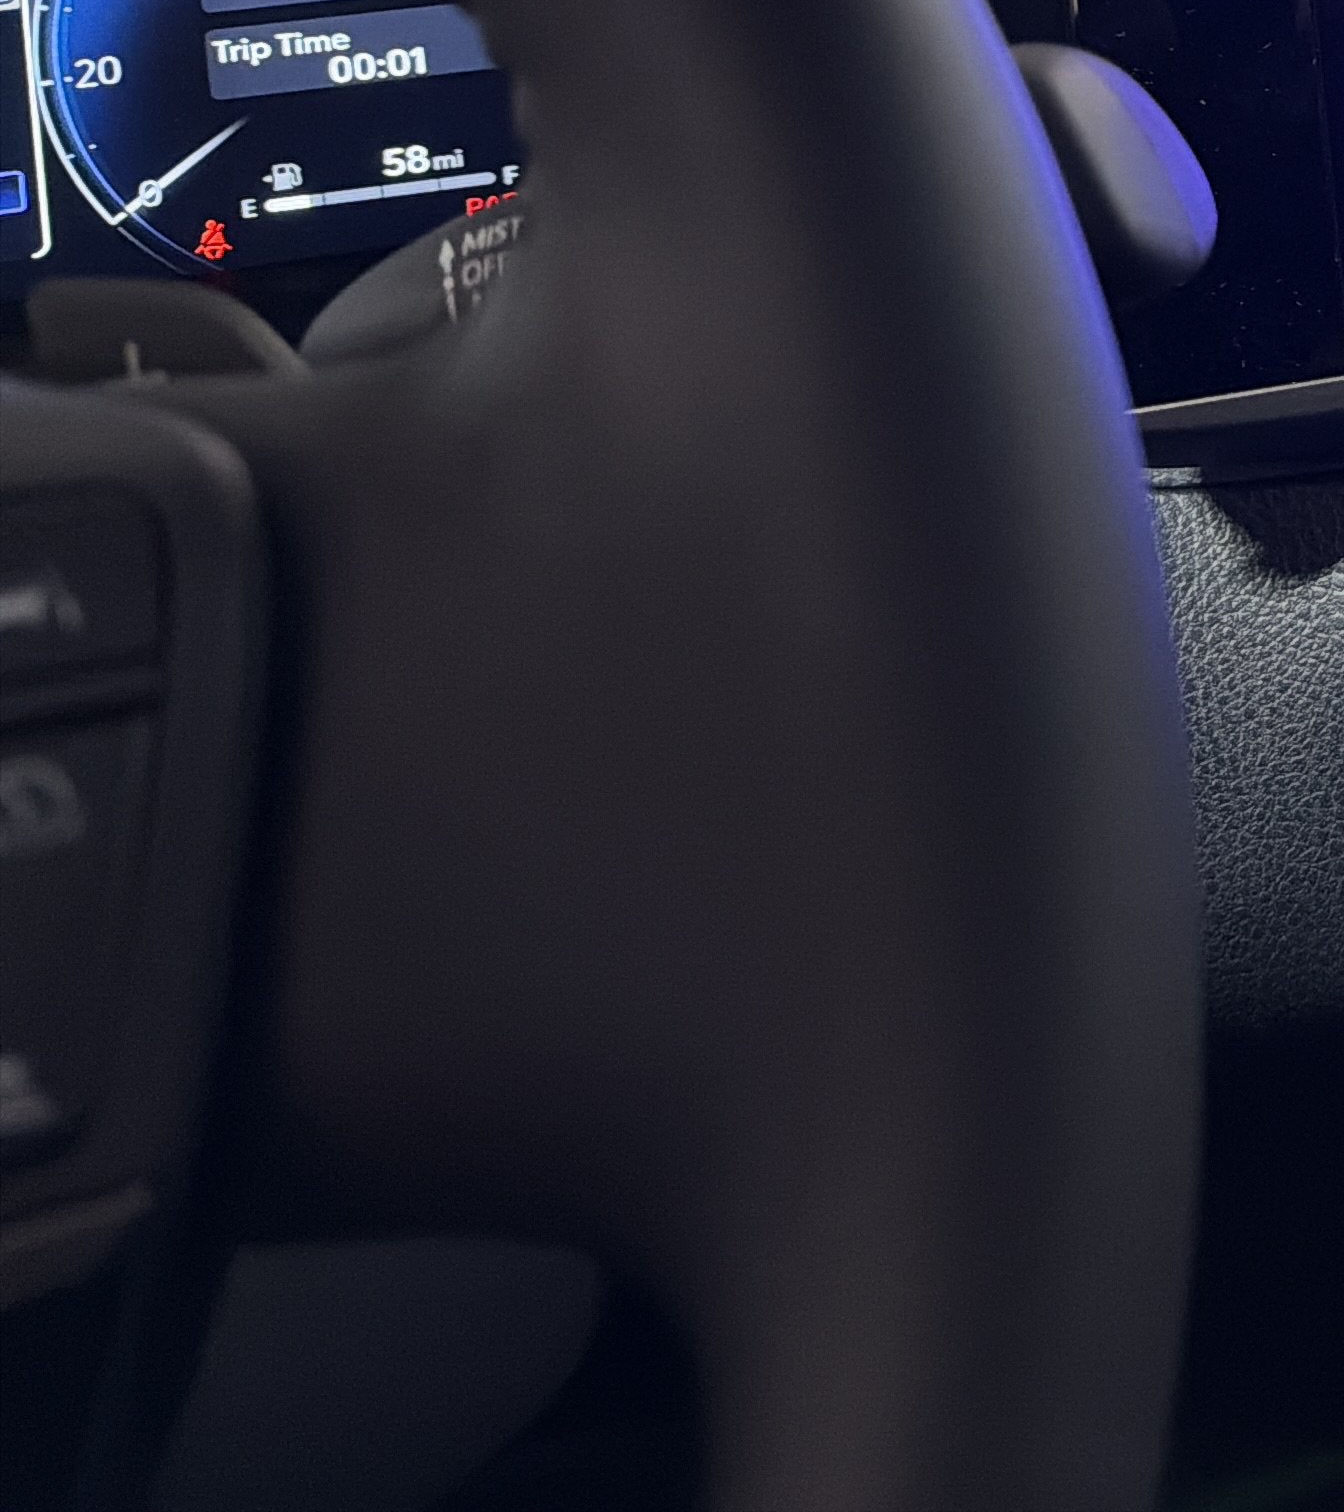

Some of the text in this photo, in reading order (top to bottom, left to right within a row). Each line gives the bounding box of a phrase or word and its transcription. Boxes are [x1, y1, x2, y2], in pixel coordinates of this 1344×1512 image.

[211, 28, 351, 68] Trip Time
[328, 46, 428, 83] 00:01
[74, 55, 122, 88] 20
[241, 199, 258, 219] E
